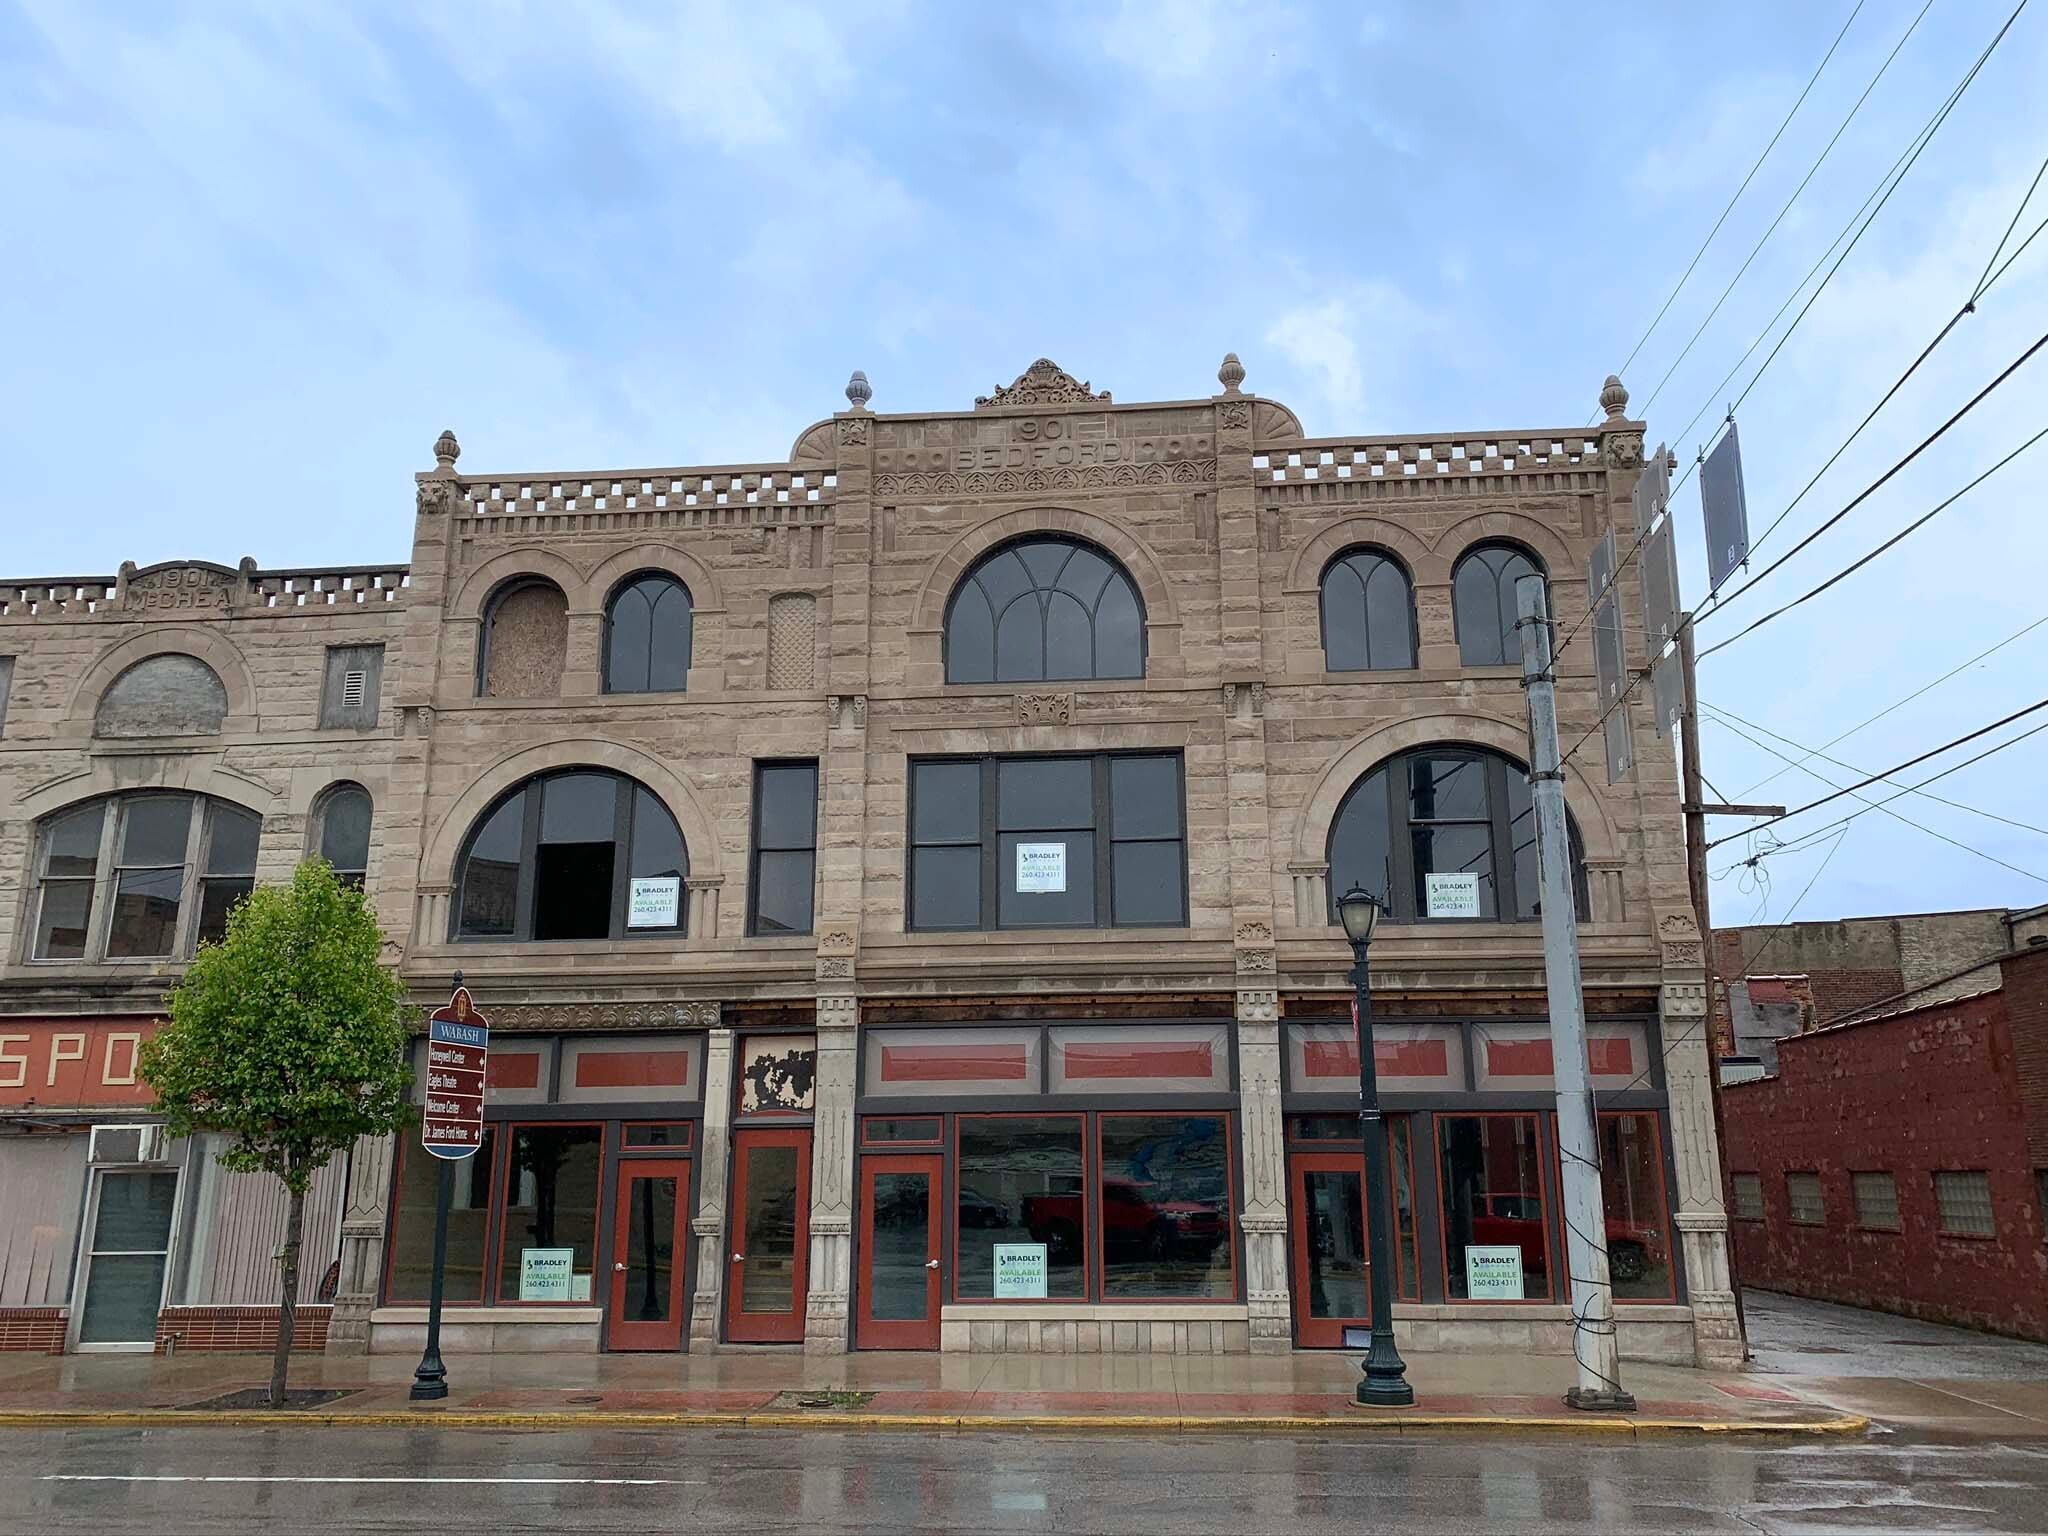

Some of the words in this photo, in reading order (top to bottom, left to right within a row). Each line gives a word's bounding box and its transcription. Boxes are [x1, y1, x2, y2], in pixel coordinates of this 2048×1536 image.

[157, 567, 208, 589] 1901
[441, 1024, 480, 1042] WABASH
[452, 1050, 465, 1064] Center
[428, 1073, 442, 1090] Eagles
[427, 1098, 446, 1113] Welcome
[446, 1100, 460, 1114] Center
[432, 1124, 445, 1139] James
[1472, 1271, 1518, 1279] AVAILABLE
